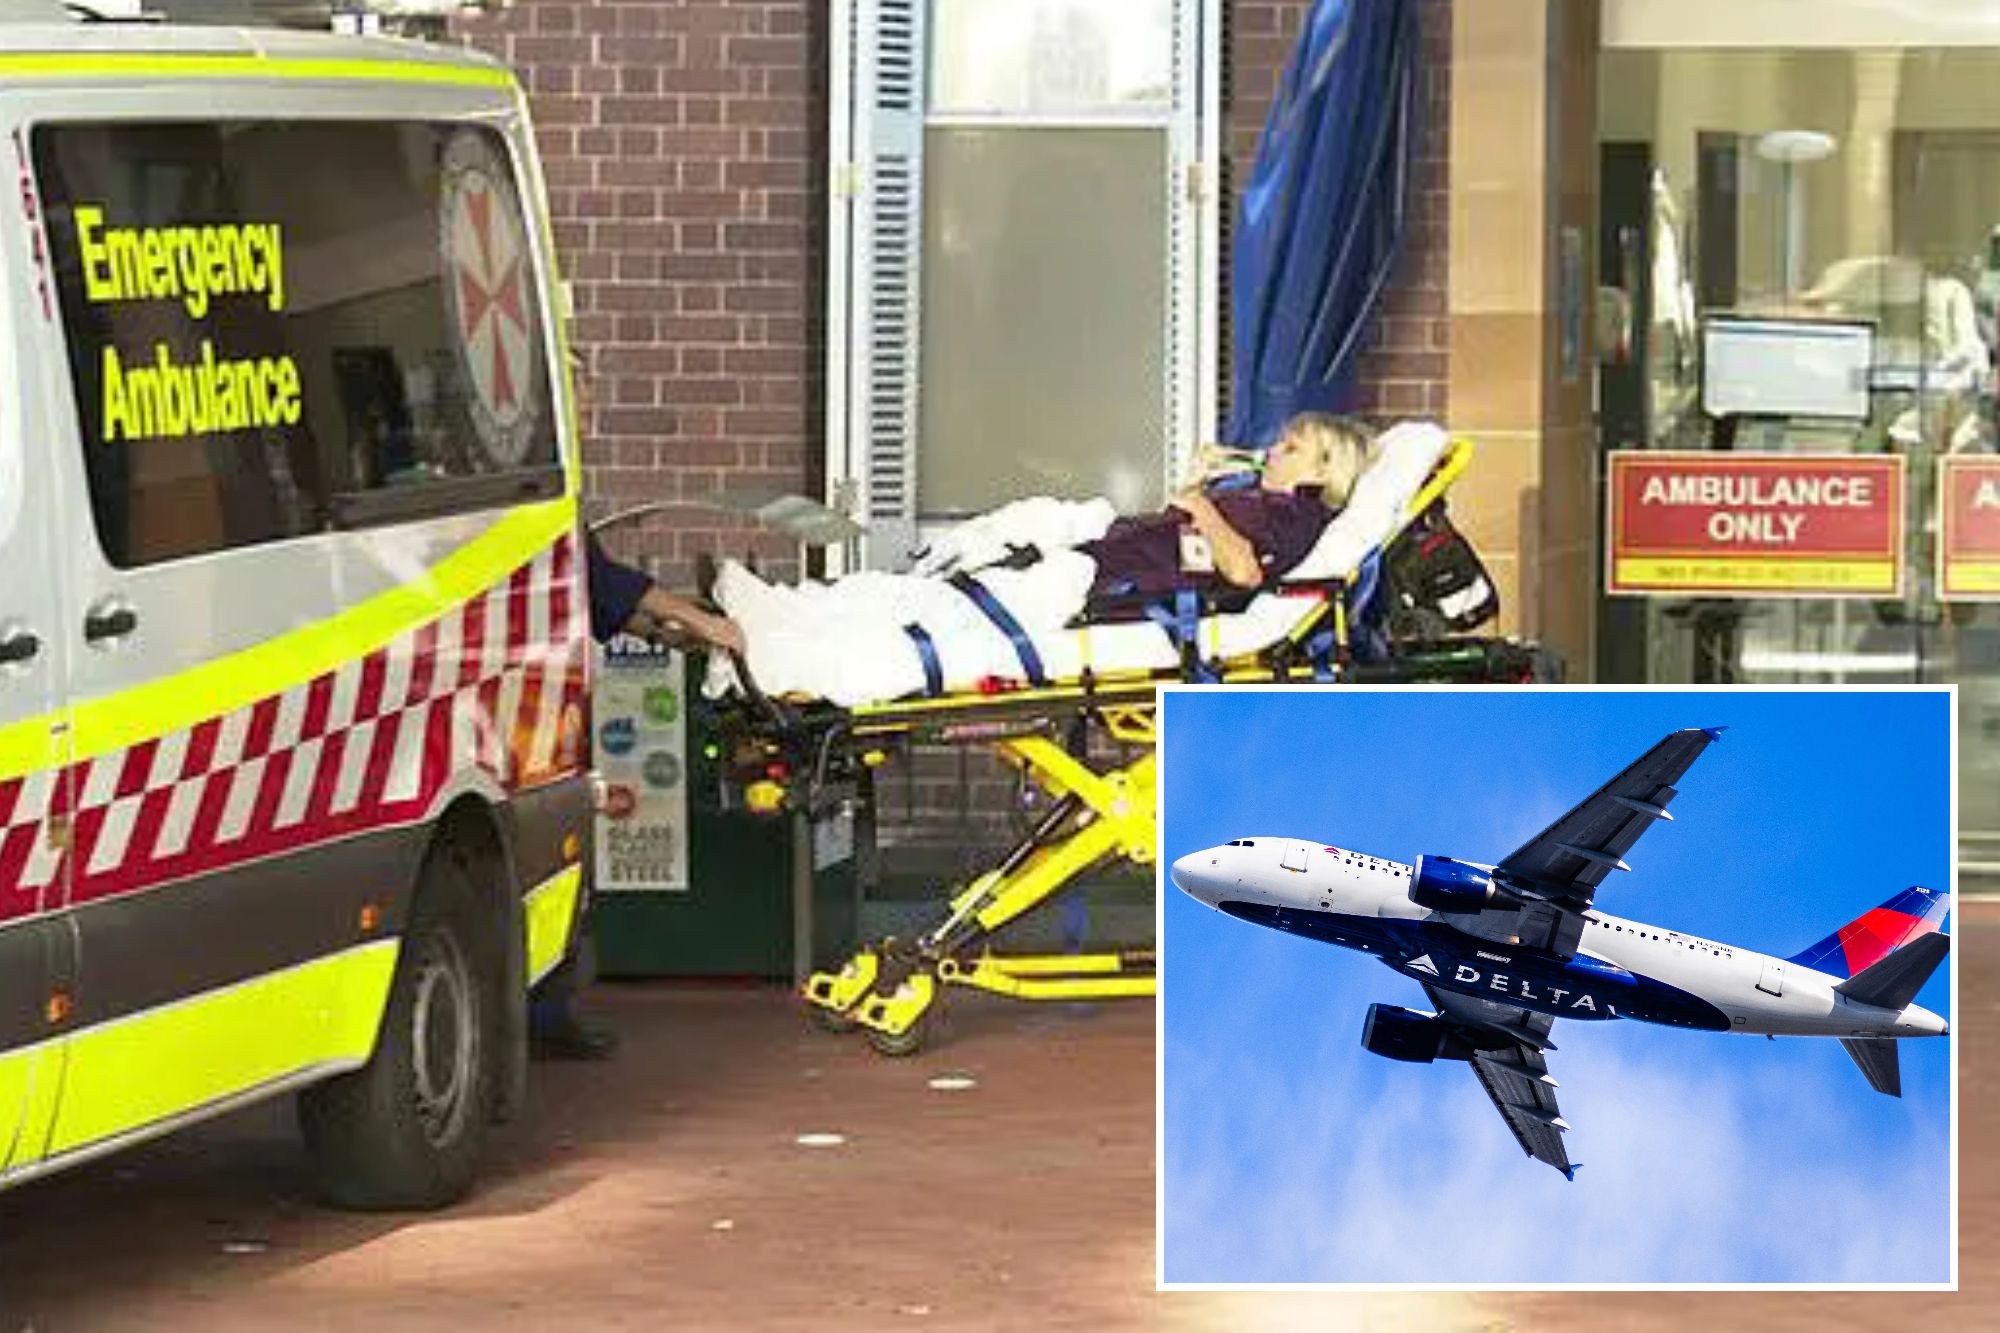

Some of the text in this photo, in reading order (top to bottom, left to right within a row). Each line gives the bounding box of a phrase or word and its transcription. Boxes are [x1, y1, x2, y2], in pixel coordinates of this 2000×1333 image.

[74, 208, 284, 318] Emergency
[104, 340, 301, 441] Ambulance
[1642, 476, 1873, 507] AMBULANCE
[1708, 512, 1806, 543] ONLY
[1455, 964, 1597, 1012] DELTA
